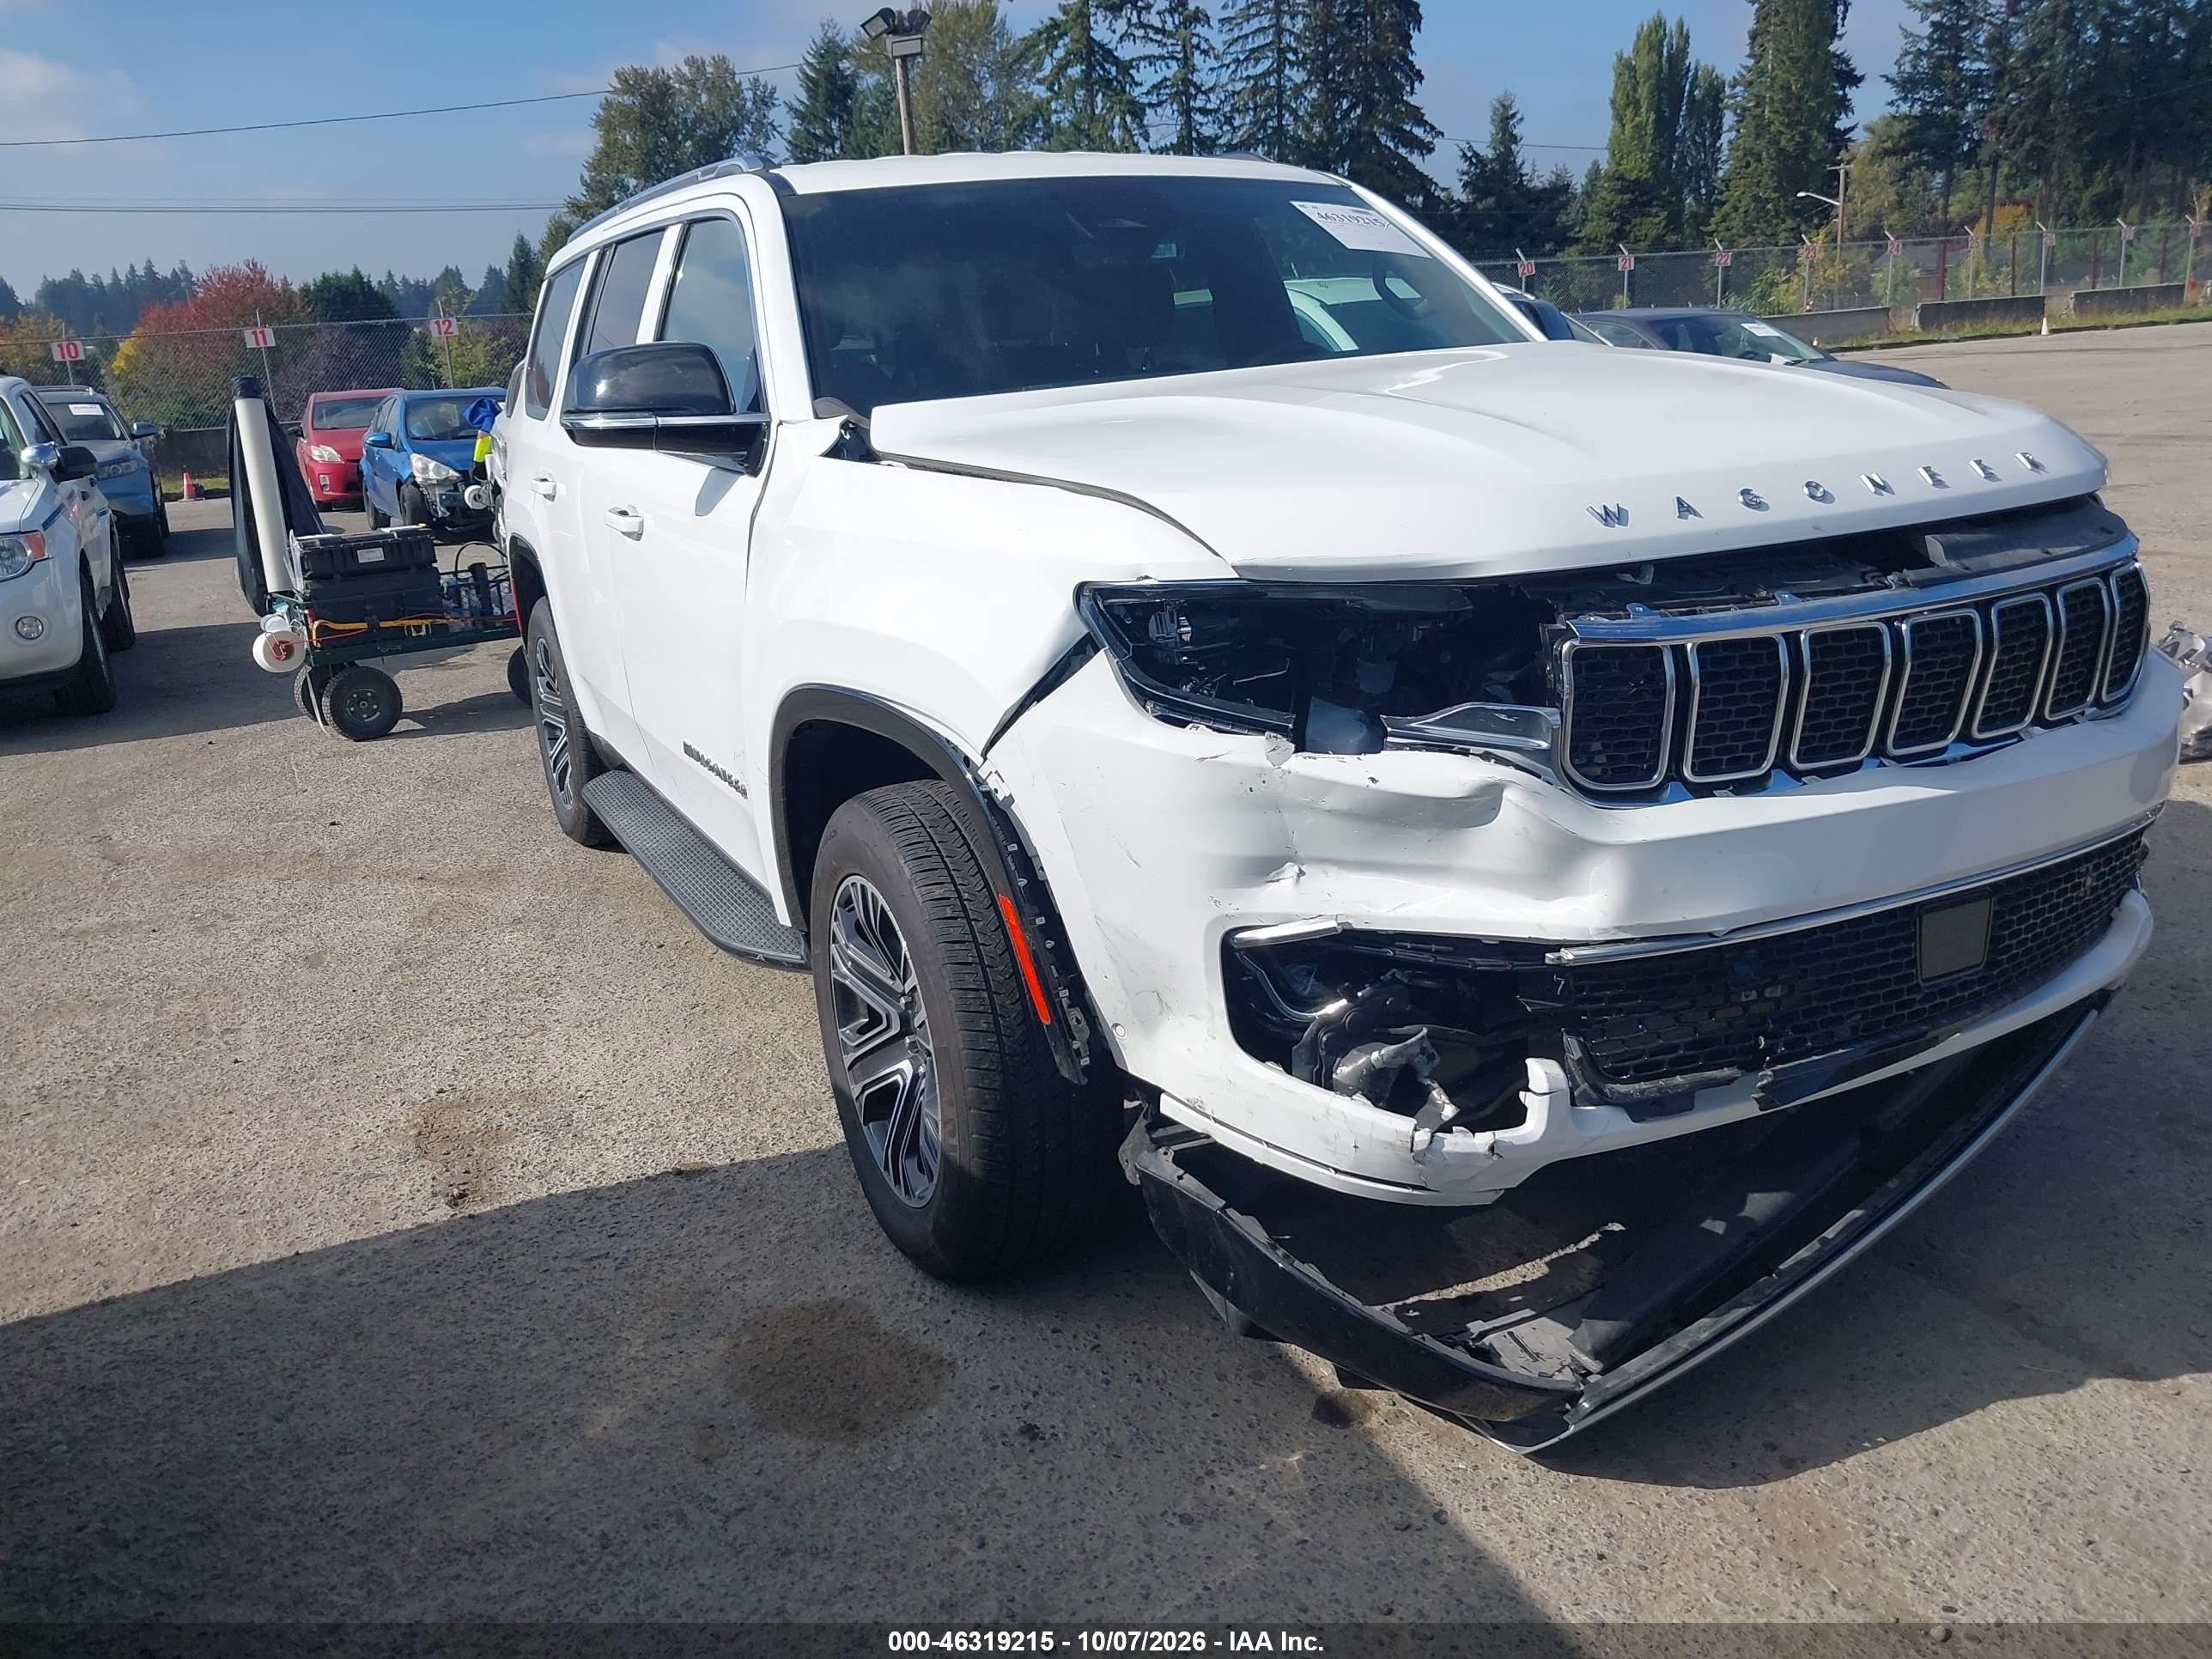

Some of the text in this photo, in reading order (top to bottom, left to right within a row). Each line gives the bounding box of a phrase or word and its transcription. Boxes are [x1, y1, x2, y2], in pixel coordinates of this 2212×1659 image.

[1717, 253, 1729, 265] 22
[1804, 247, 1816, 259] 23
[1519, 262, 1534, 276] 20
[1620, 256, 1632, 270] 21
[434, 319, 454, 336] 12
[252, 329, 269, 346] 11
[57, 343, 80, 360] 10
[1586, 451, 2045, 528] WAGONEER
